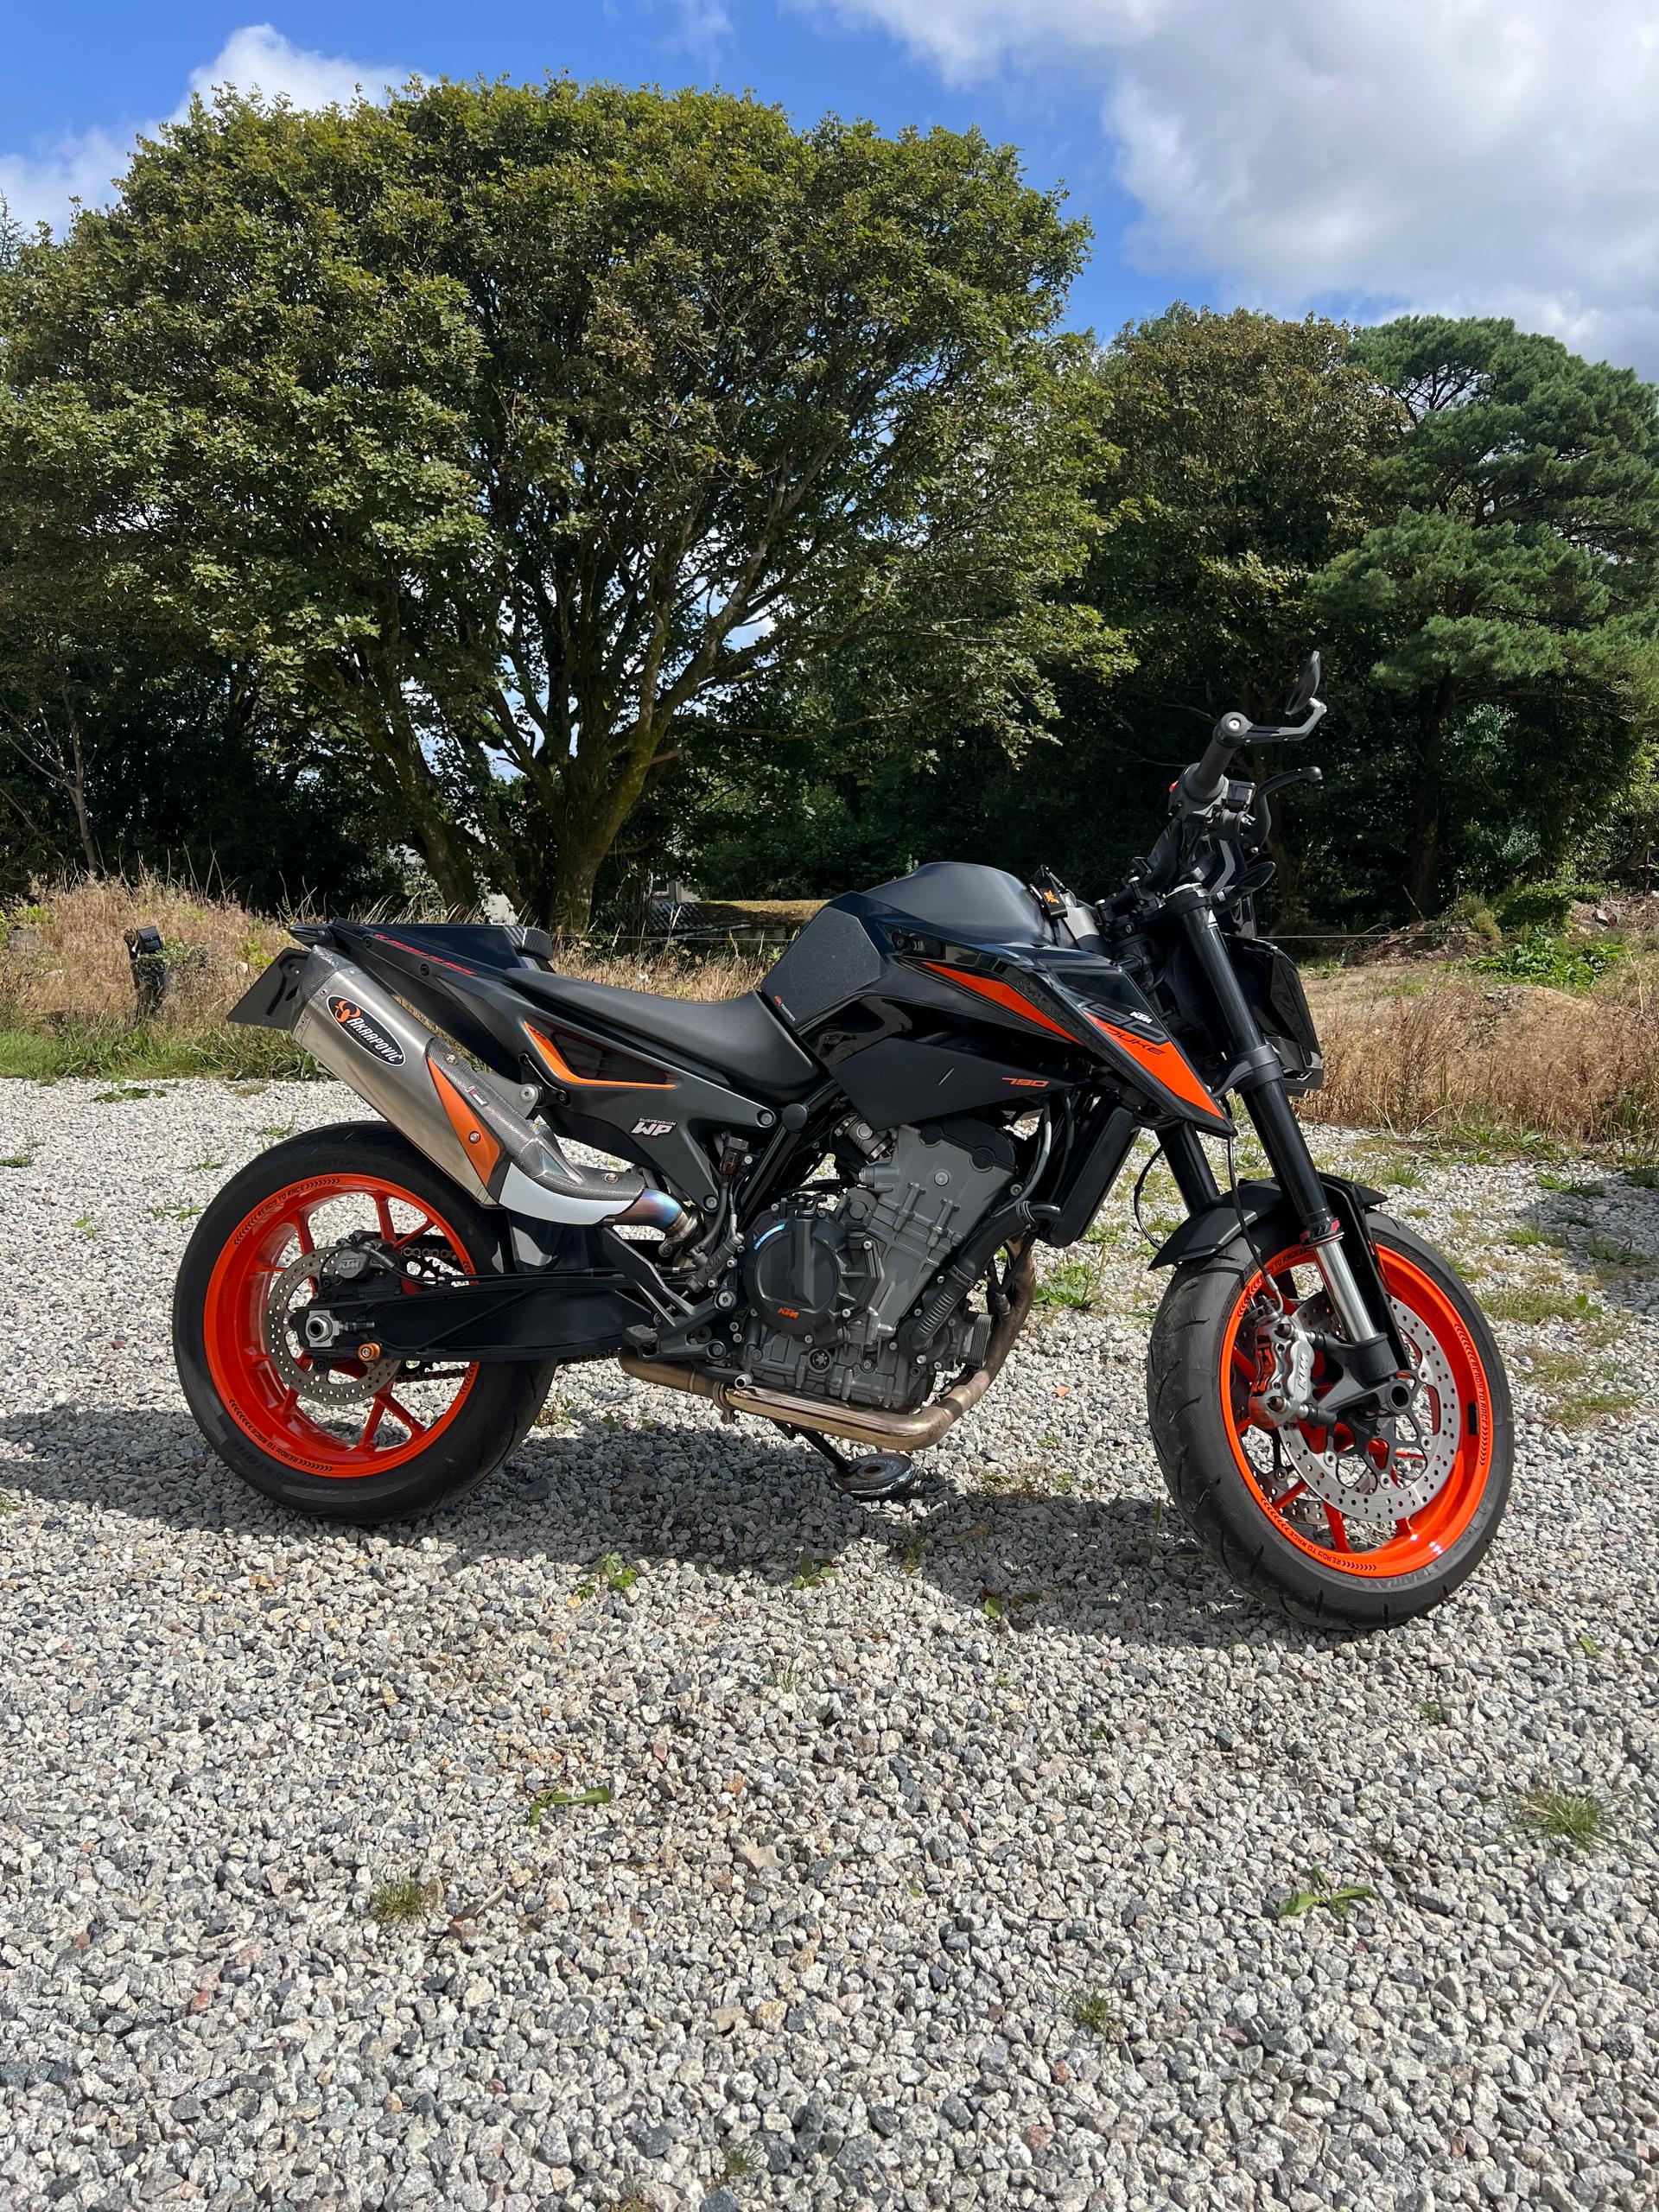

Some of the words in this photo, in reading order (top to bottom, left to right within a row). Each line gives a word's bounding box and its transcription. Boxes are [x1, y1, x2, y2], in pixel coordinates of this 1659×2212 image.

[1128, 1011, 1153, 1024] KTM
[1103, 1027, 1166, 1055] DUKE
[1001, 1077, 1049, 1087] 790
[631, 1122, 673, 1136] WP
[257, 1198, 276, 1217] READY
[287, 1185, 305, 1197] RACE
[338, 1259, 360, 1269] KTM
[778, 1306, 799, 1319] KTM
[1471, 1361, 1482, 1389] READY
[1478, 1390, 1486, 1402] TO
[251, 1427, 268, 1444] RACE
[267, 1441, 276, 1451] TO
[276, 1447, 299, 1462] READY
[1290, 1530, 1307, 1548] RACE
[1308, 1545, 1318, 1554] TO
[1318, 1552, 1342, 1566] READY
